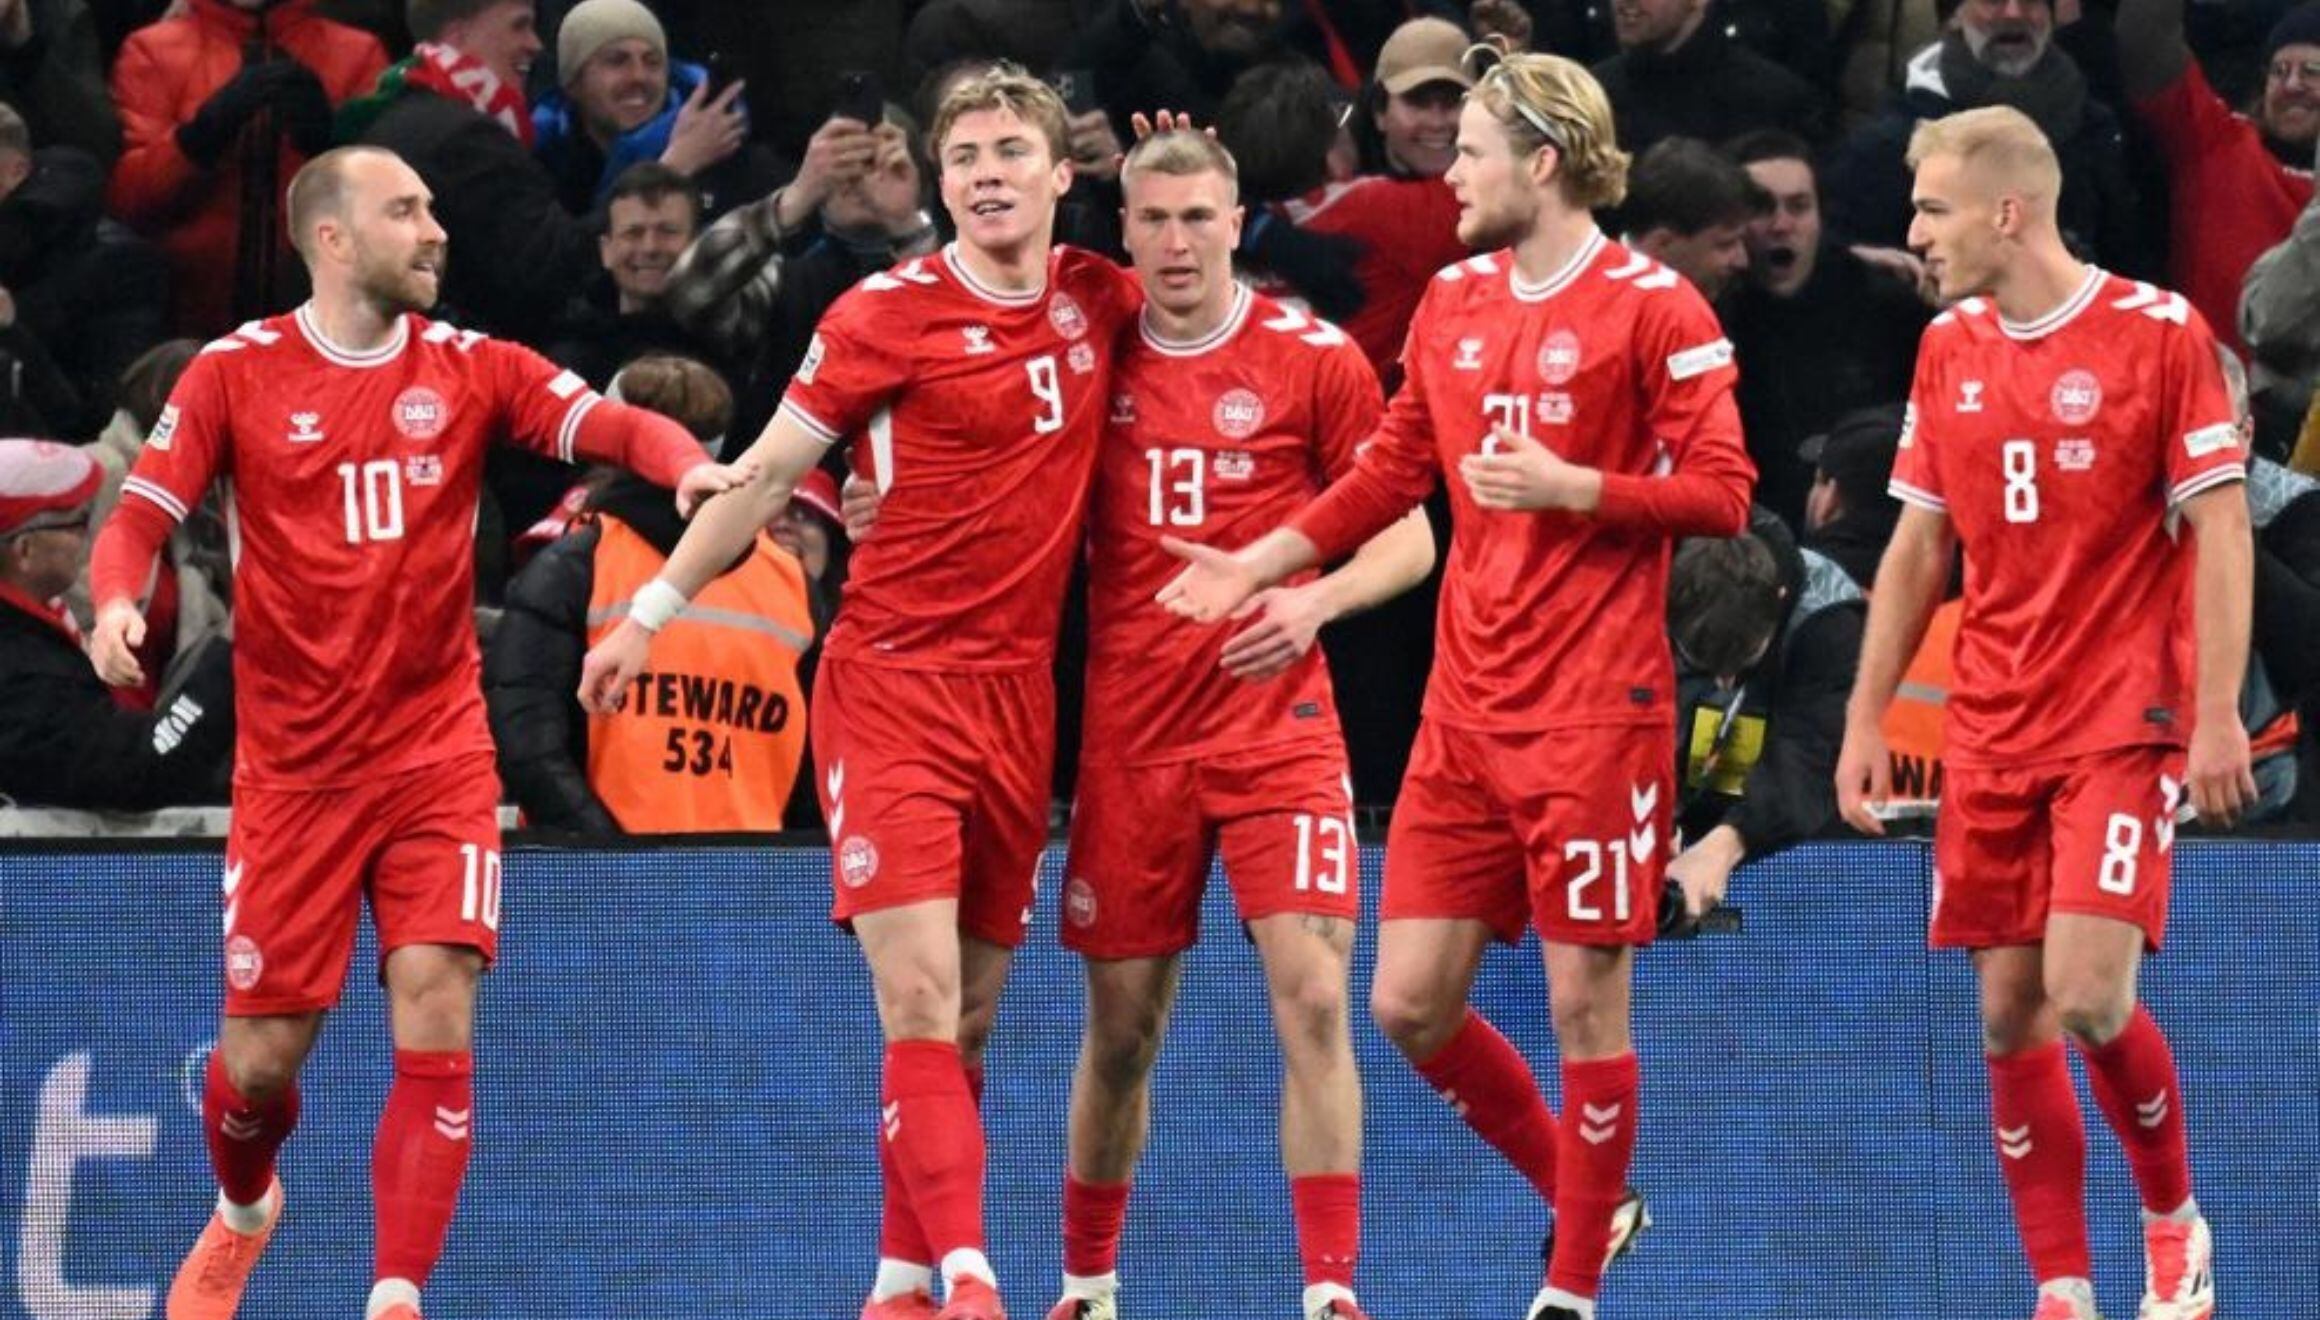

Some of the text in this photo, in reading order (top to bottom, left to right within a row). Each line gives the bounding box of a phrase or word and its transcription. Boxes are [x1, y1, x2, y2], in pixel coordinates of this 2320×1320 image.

[1026, 355, 1063, 434] 9
[1482, 394, 1530, 458] 21
[337, 460, 405, 544] 10
[1145, 448, 1204, 526] 13
[2003, 440, 2039, 524] 8
[663, 727, 734, 779] 534
[460, 843, 501, 931] 10
[1292, 814, 1347, 894] 13
[1564, 840, 1630, 920] 21
[2098, 812, 2142, 896] 8
